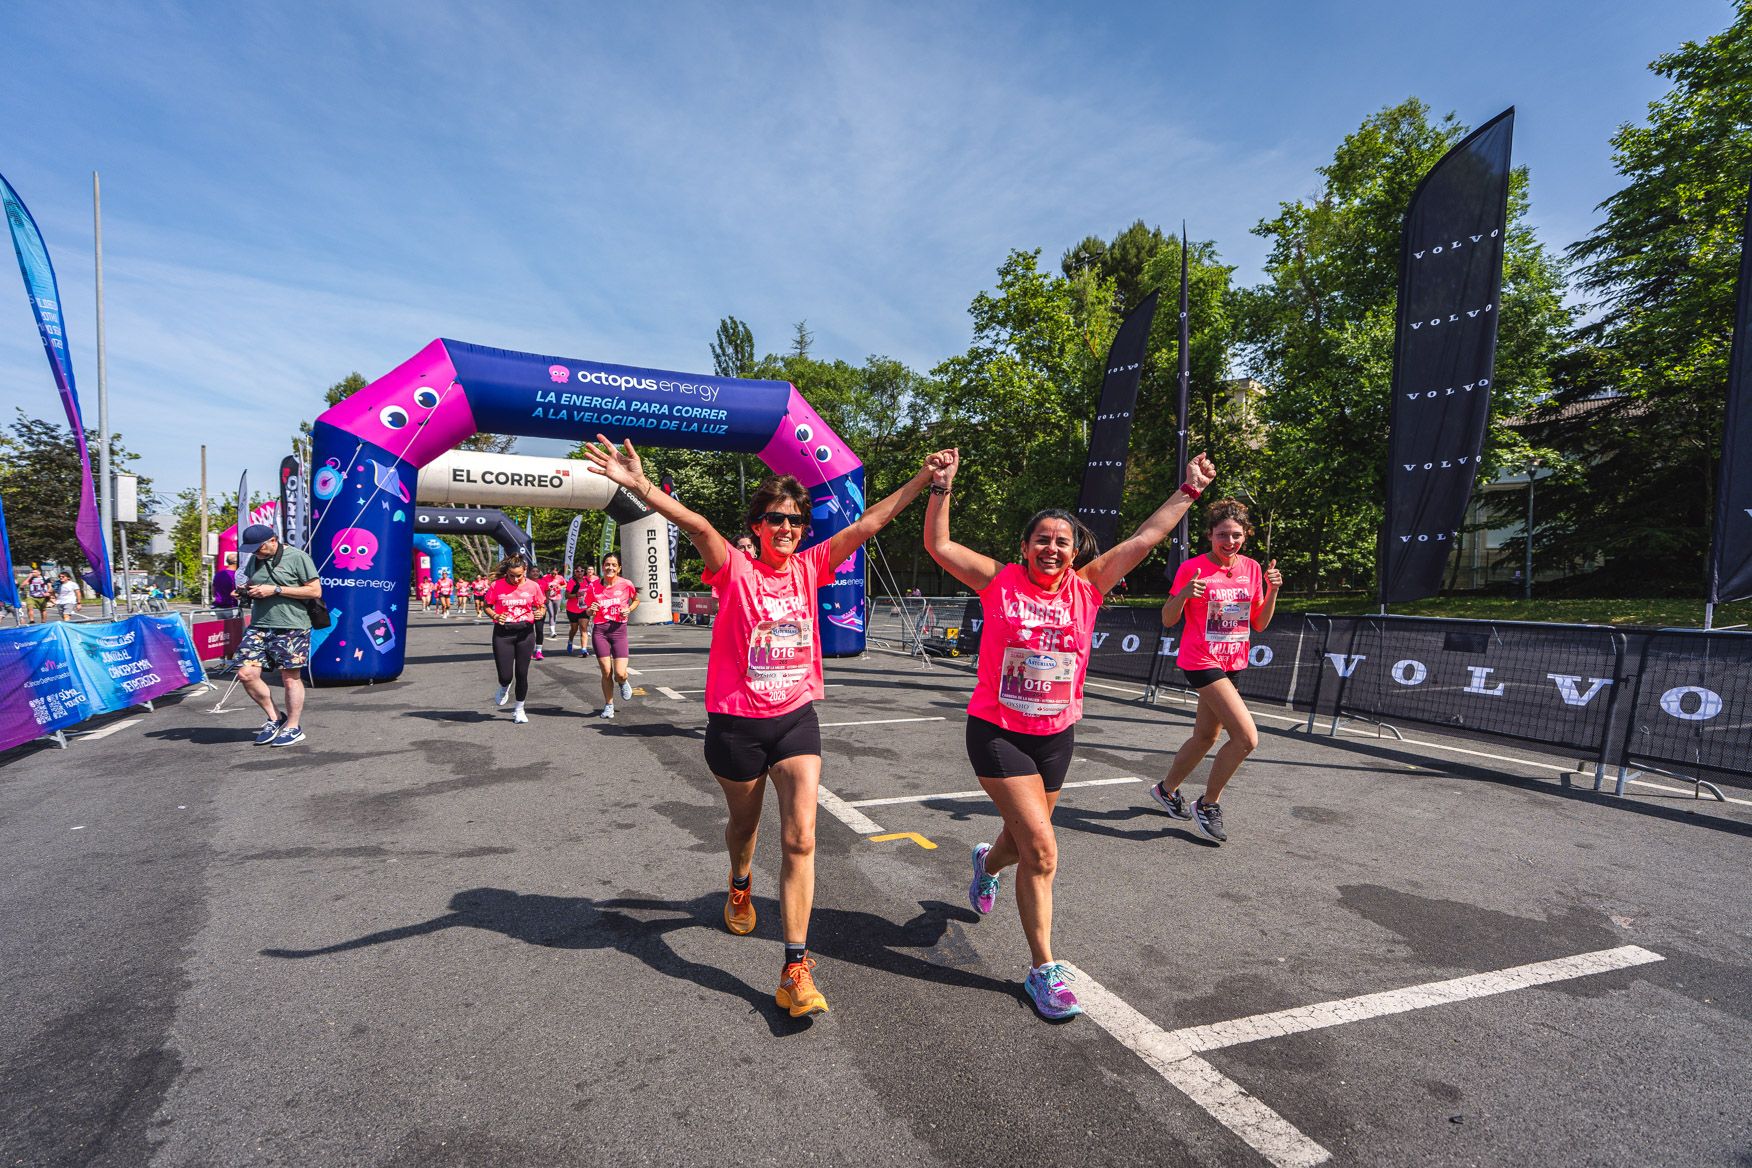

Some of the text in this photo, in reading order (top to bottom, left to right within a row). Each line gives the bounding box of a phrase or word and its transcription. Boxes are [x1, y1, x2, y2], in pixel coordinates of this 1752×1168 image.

[1413, 229, 1499, 259] VOLVO
[1410, 303, 1492, 330] VOLVO
[577, 371, 720, 402] octopus energy
[1406, 379, 1489, 400] VOLVO
[535, 390, 728, 420] LA ENERGÍA PARA CORRER
[531, 407, 729, 435] A LA VELOCIDAD DE LA LUZ
[1403, 456, 1482, 471] VOLVO
[452, 468, 564, 489] EL CORREO
[286, 475, 298, 545] ORREO
[620, 486, 647, 512] EL CORREO
[418, 515, 487, 525] OLVO
[567, 519, 579, 561] AMUTIO
[603, 516, 615, 555] MUTI
[646, 529, 659, 600] EL CORREO
[319, 576, 397, 592] topus energy
[1209, 587, 1250, 601] CARRERA
[1007, 600, 1072, 626] CARRERA
[1222, 620, 1239, 628] 016
[771, 647, 795, 658] 016
[1024, 679, 1052, 692] 016
[1324, 652, 1724, 721] VOLVO
